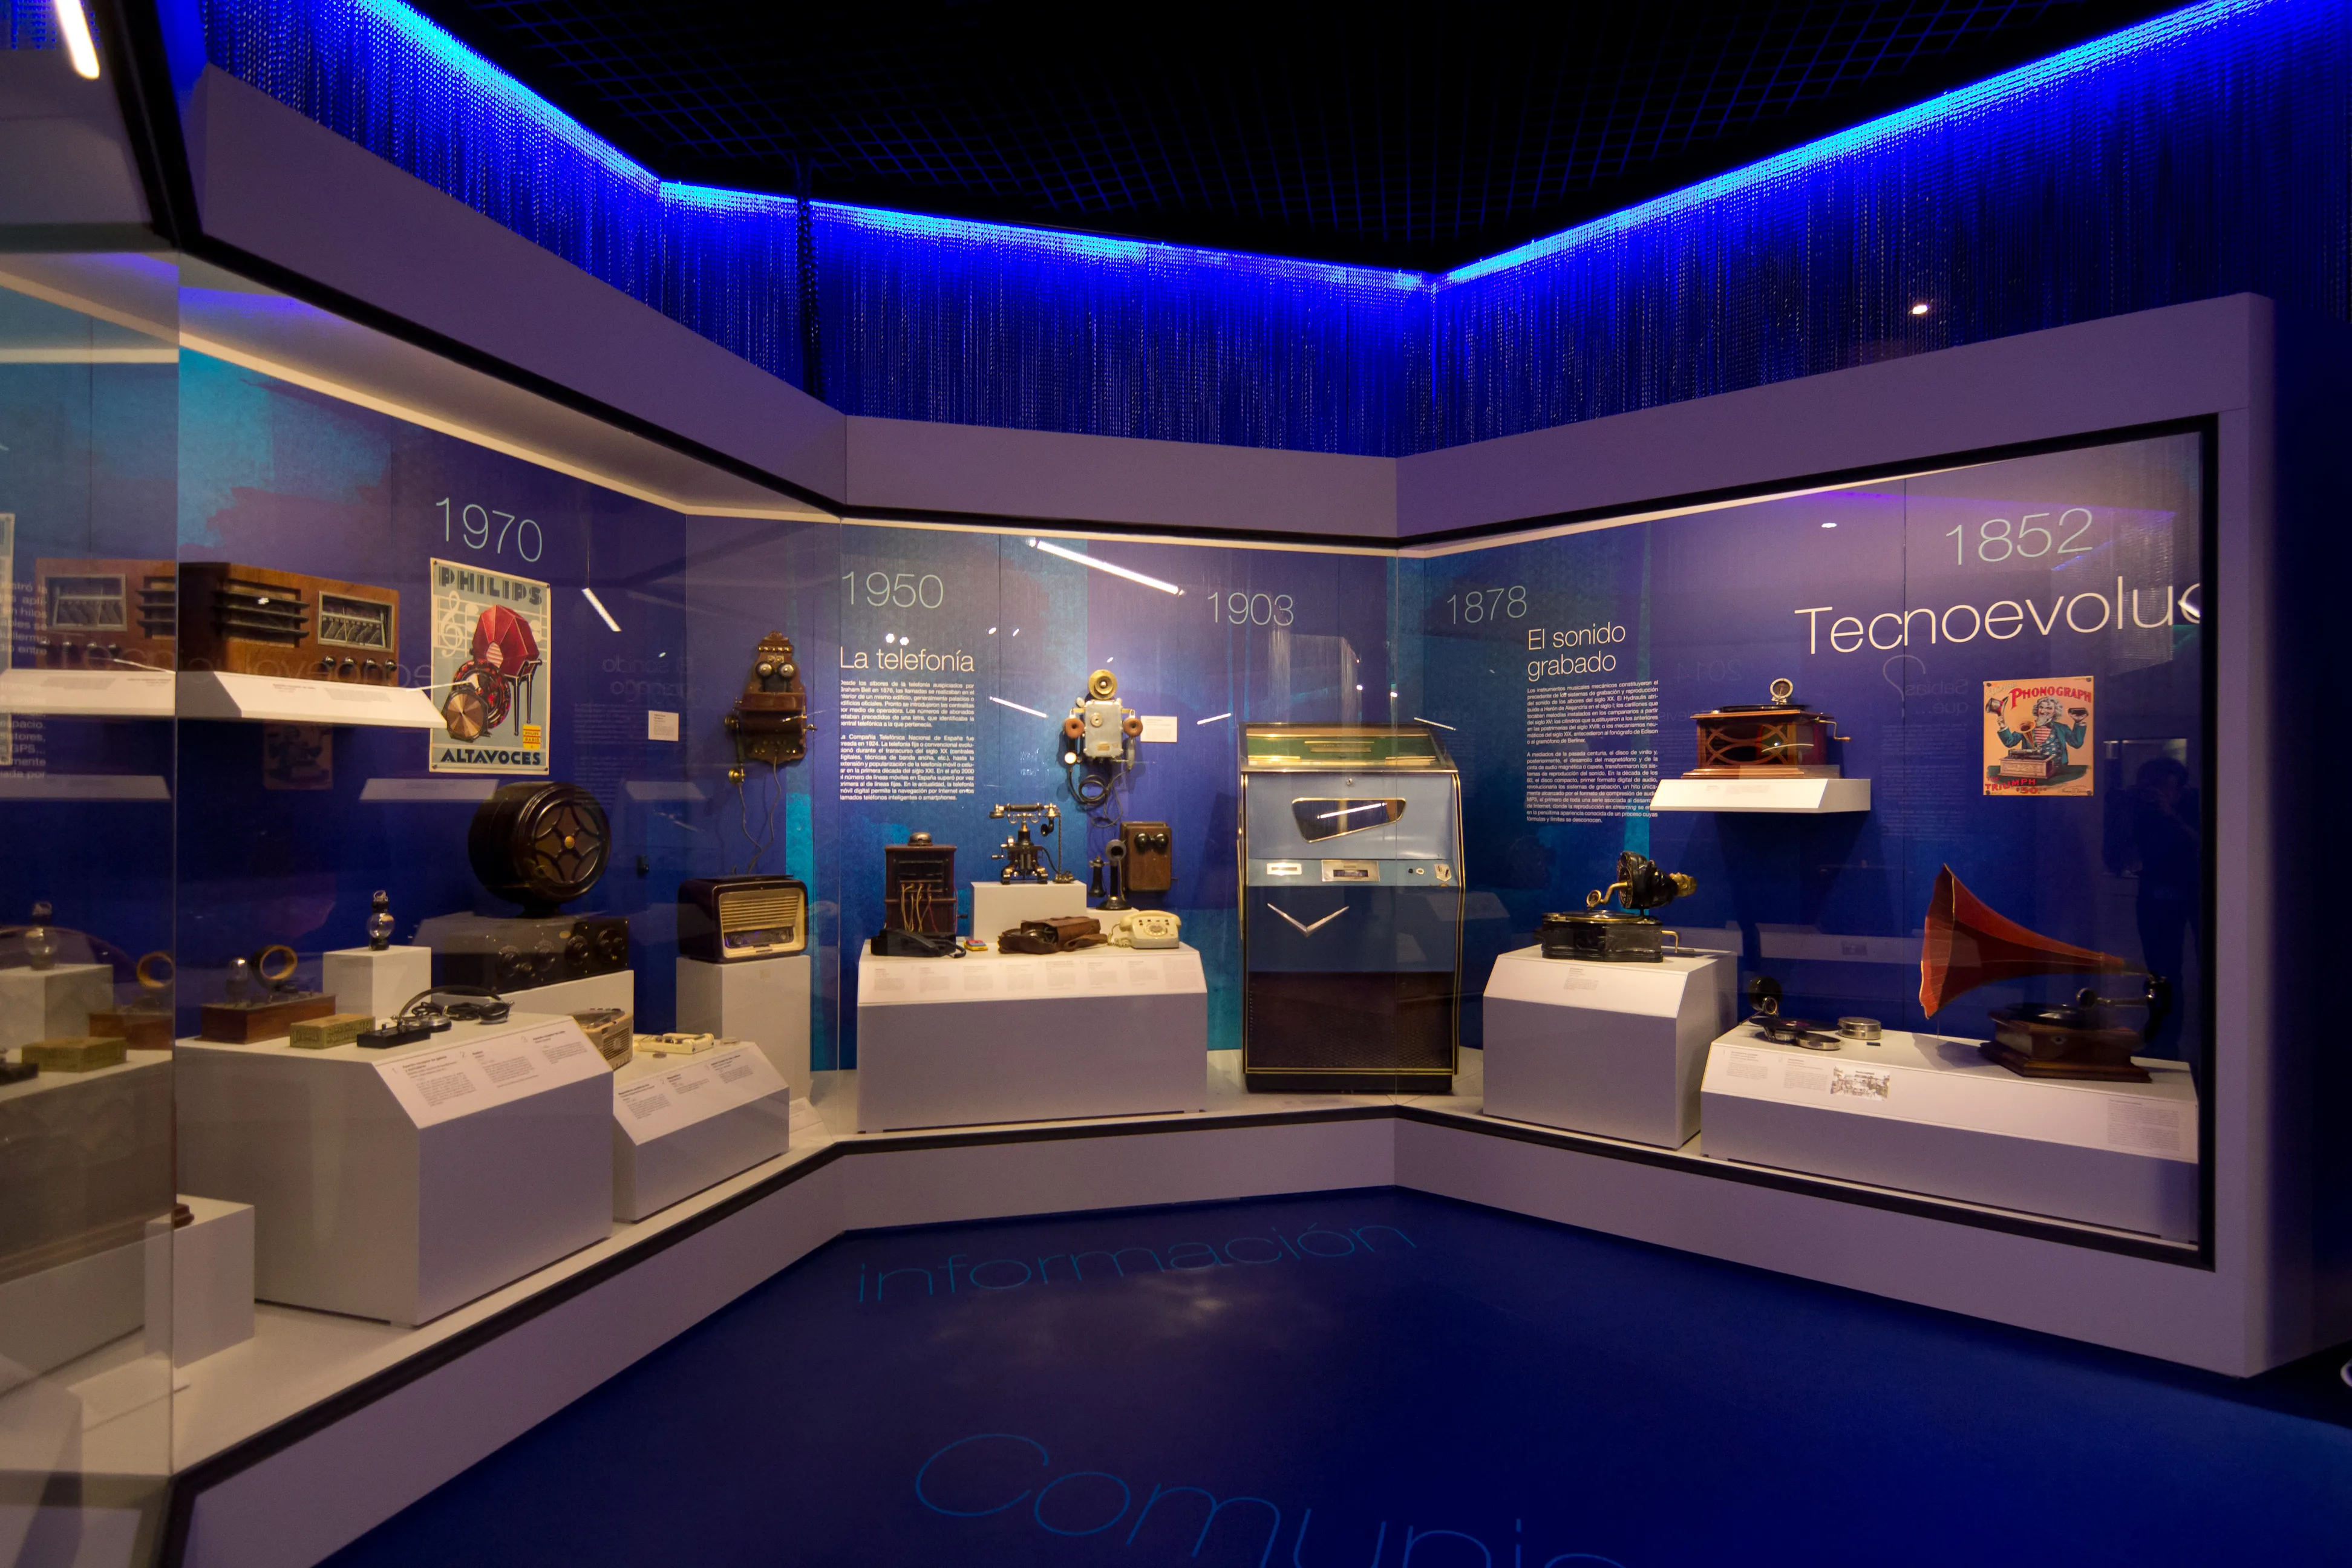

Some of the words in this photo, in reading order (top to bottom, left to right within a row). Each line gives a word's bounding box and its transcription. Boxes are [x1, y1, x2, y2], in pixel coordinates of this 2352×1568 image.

[436, 498, 542, 563] 1970
[1945, 508, 2093, 565] 1852
[439, 566, 542, 605] PHILIPS
[842, 571, 944, 609] 1950
[1207, 591, 1294, 626] 1903
[1446, 585, 1527, 625] 1878
[1528, 629, 1545, 650] El
[1552, 622, 1625, 649] sonido
[840, 646, 869, 668] La
[876, 648, 975, 672] telefonía
[1528, 651, 1616, 682] grabado
[2009, 686, 2091, 710] PHONOGRAPH
[440, 748, 541, 765] ALTAVOCES
[1985, 779, 2036, 791] TRIUMPH
[858, 1222, 1416, 1302] información
[915, 1432, 1627, 1568] Comun
